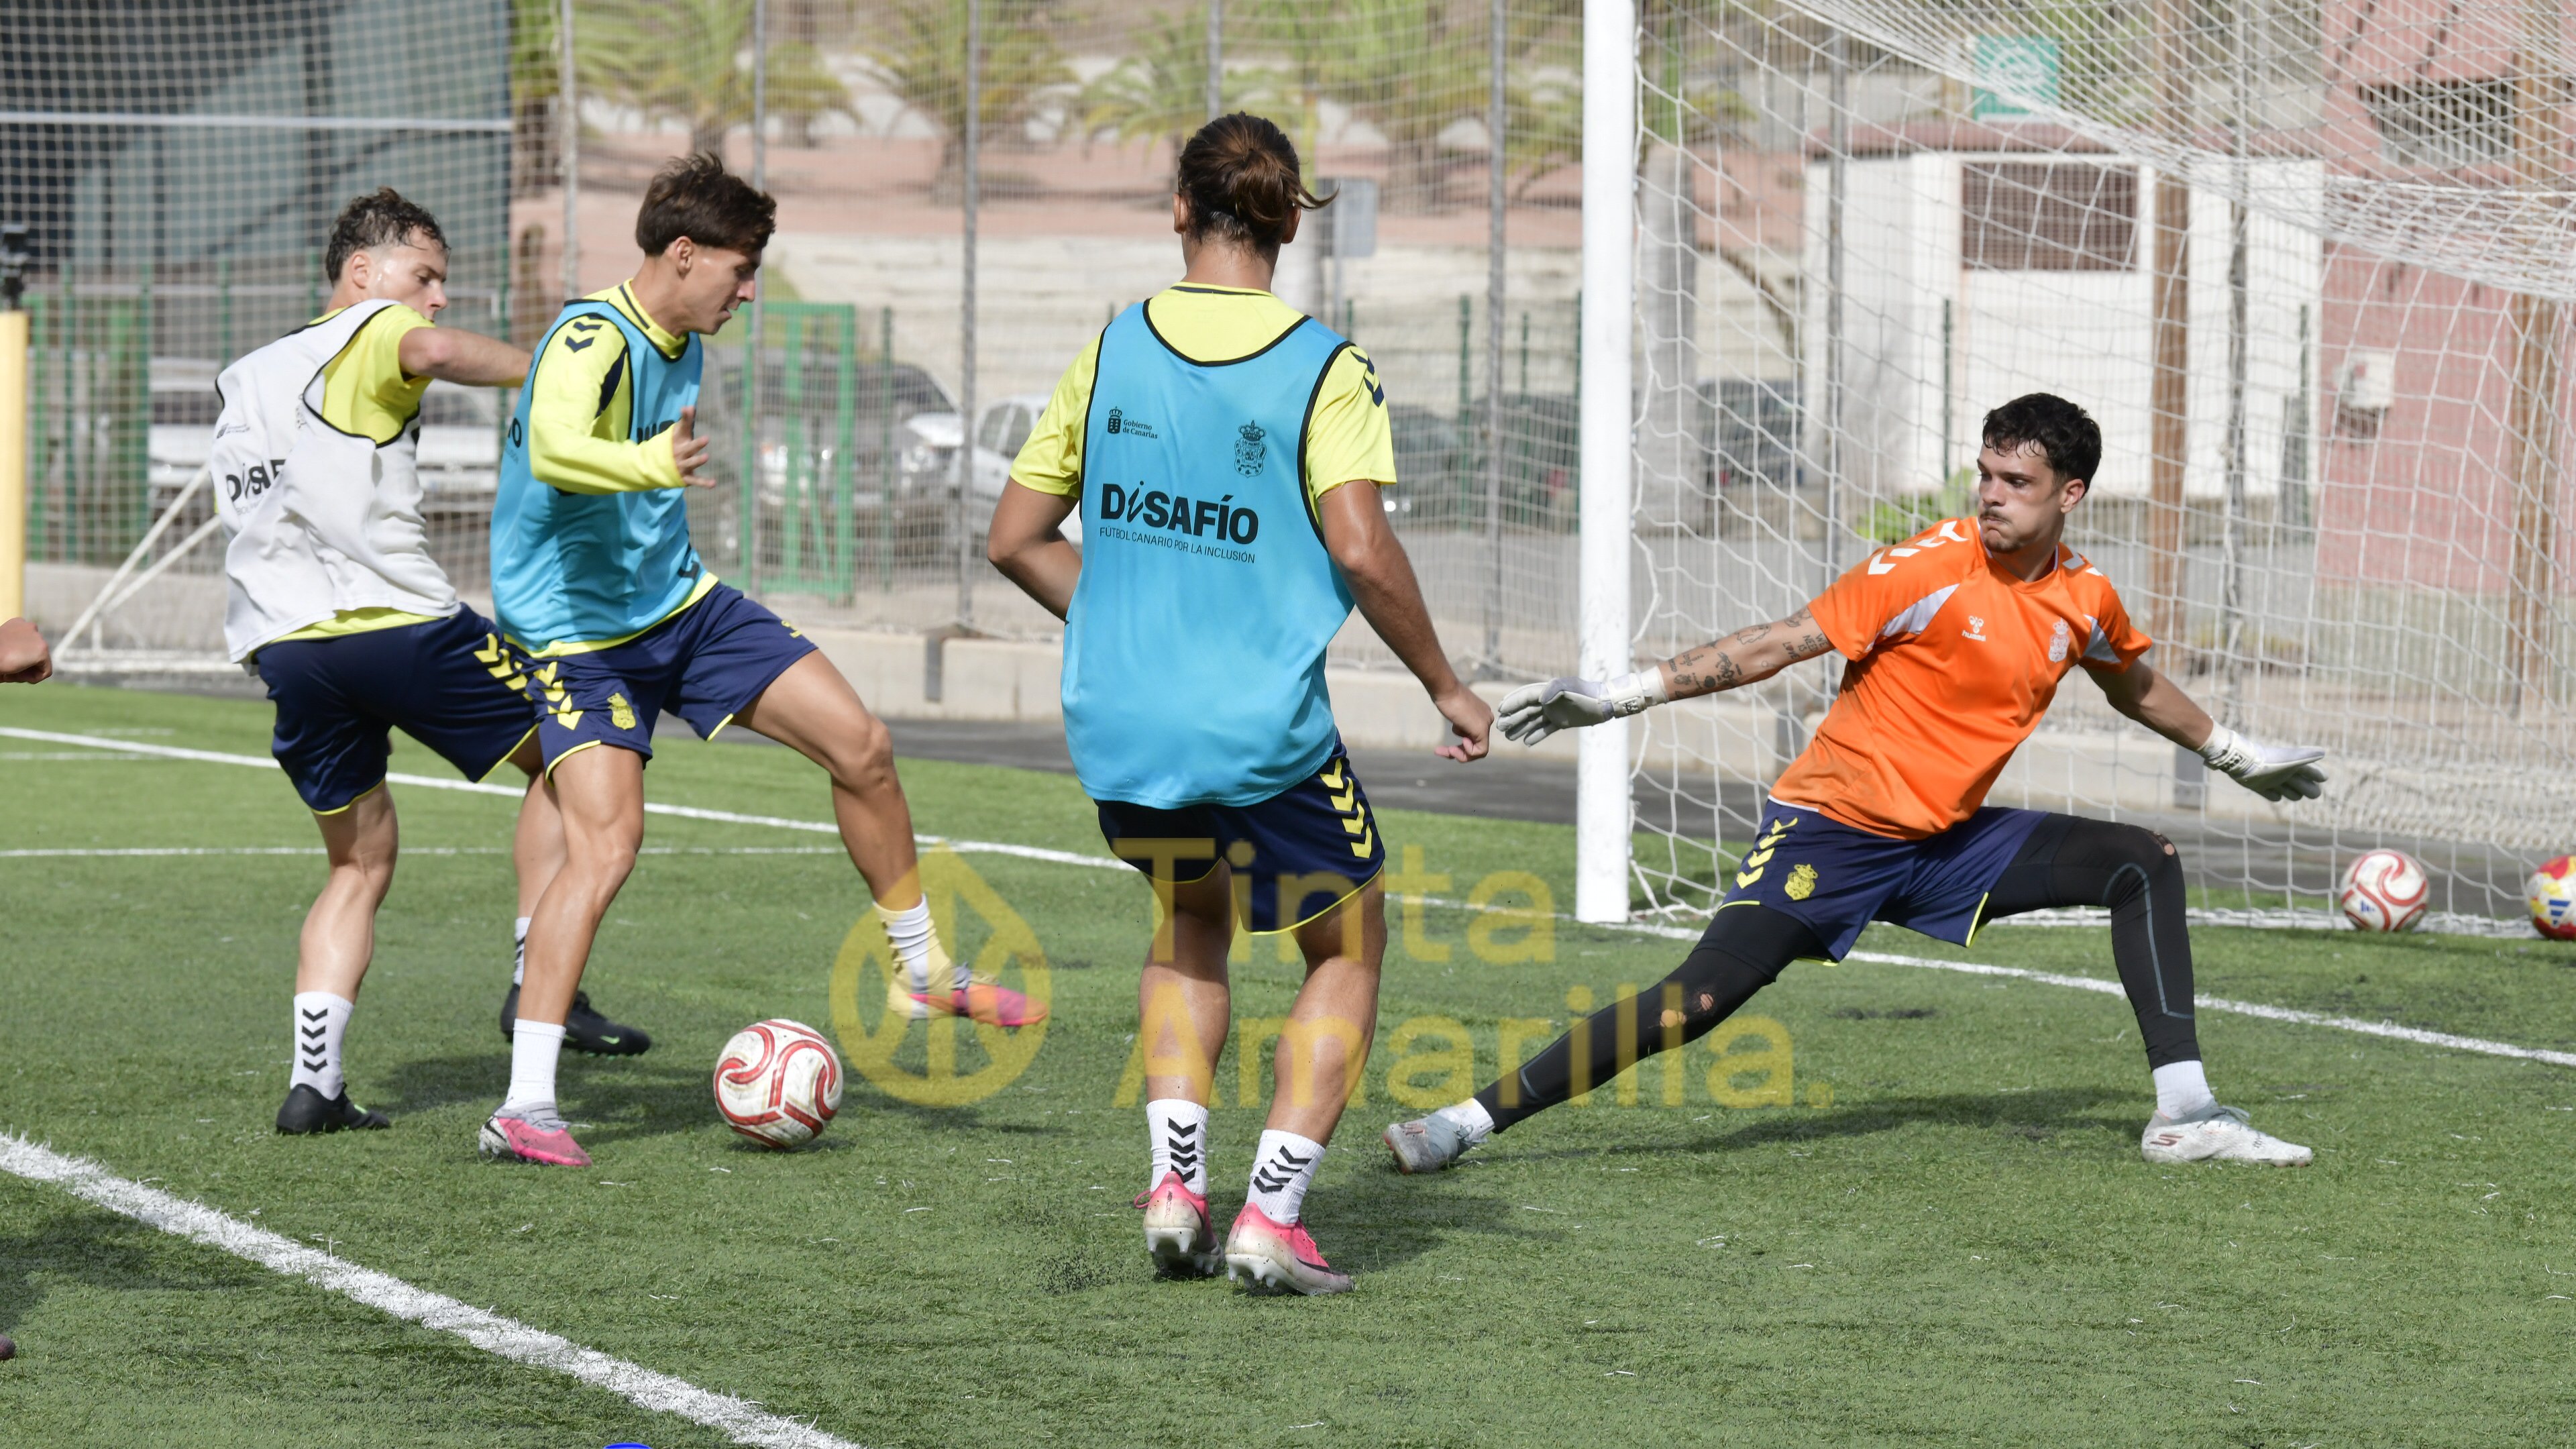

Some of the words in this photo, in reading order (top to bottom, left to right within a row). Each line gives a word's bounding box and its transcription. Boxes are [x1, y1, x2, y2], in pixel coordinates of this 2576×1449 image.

[1124, 419, 1152, 431] Gobierno
[1122, 426, 1130, 434] de
[1130, 428, 1159, 439] Canarias
[1099, 526, 1130, 539] FÚTBOL
[1132, 531, 1173, 548] CANARIO
[1174, 539, 1189, 551] POR
[1191, 543, 1203, 555] LA
[1204, 545, 1256, 564] INCLUSIÓN
[1815, 633, 1829, 648] WE
[1962, 630, 1986, 642] hummel
[1797, 644, 1808, 652] IS
[1803, 635, 1819, 653] NEED
